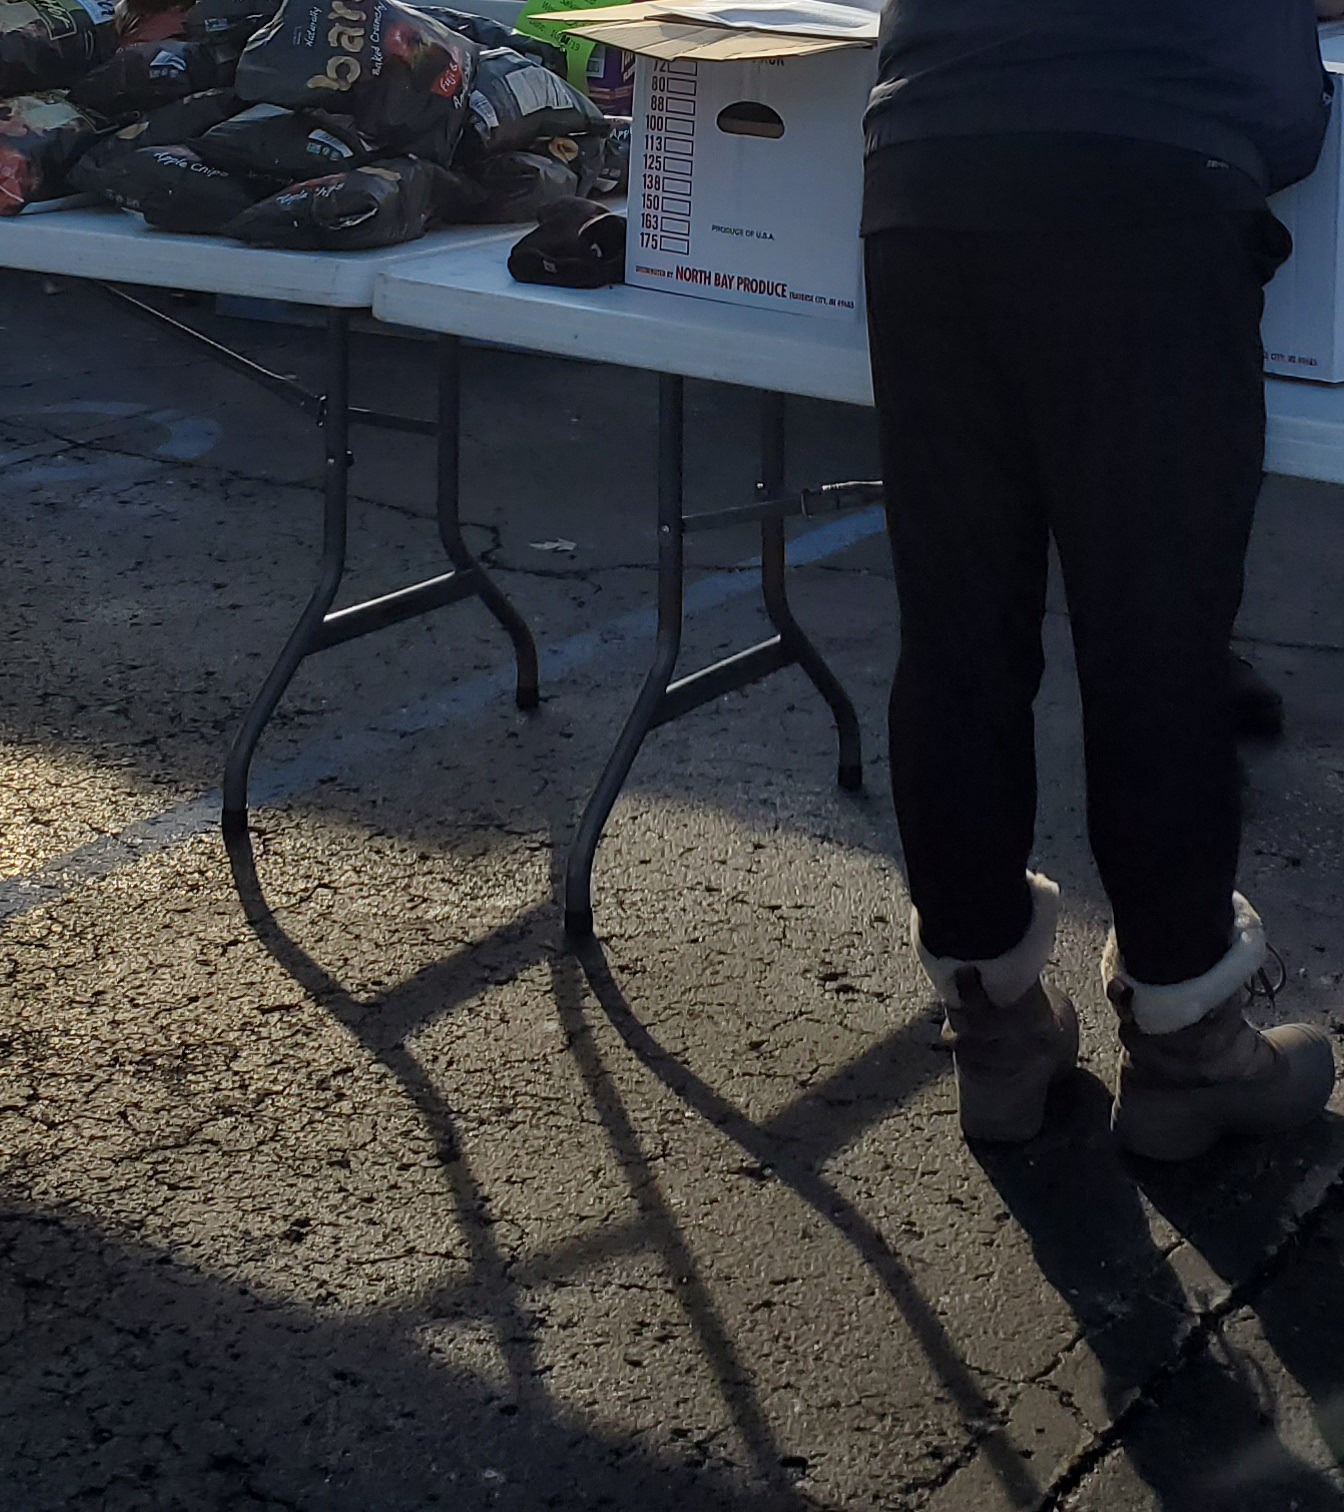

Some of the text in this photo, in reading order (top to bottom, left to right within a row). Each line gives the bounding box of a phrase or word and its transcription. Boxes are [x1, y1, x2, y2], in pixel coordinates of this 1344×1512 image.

[652, 76, 666, 92] 80
[651, 95, 664, 112] 88
[645, 114, 664, 132] 100
[609, 128, 630, 141] App
[645, 135, 662, 151] 113
[190, 162, 229, 178] Chips
[643, 153, 662, 171] 125
[642, 173, 661, 191] 138
[641, 193, 660, 211] 150
[640, 212, 659, 230] 163
[711, 224, 744, 237] PRODUCE
[745, 228, 755, 237] OF
[640, 232, 658, 250] 175
[675, 265, 711, 286] NORTH
[714, 272, 735, 290] BAY
[737, 276, 788, 299] PRODUCE
